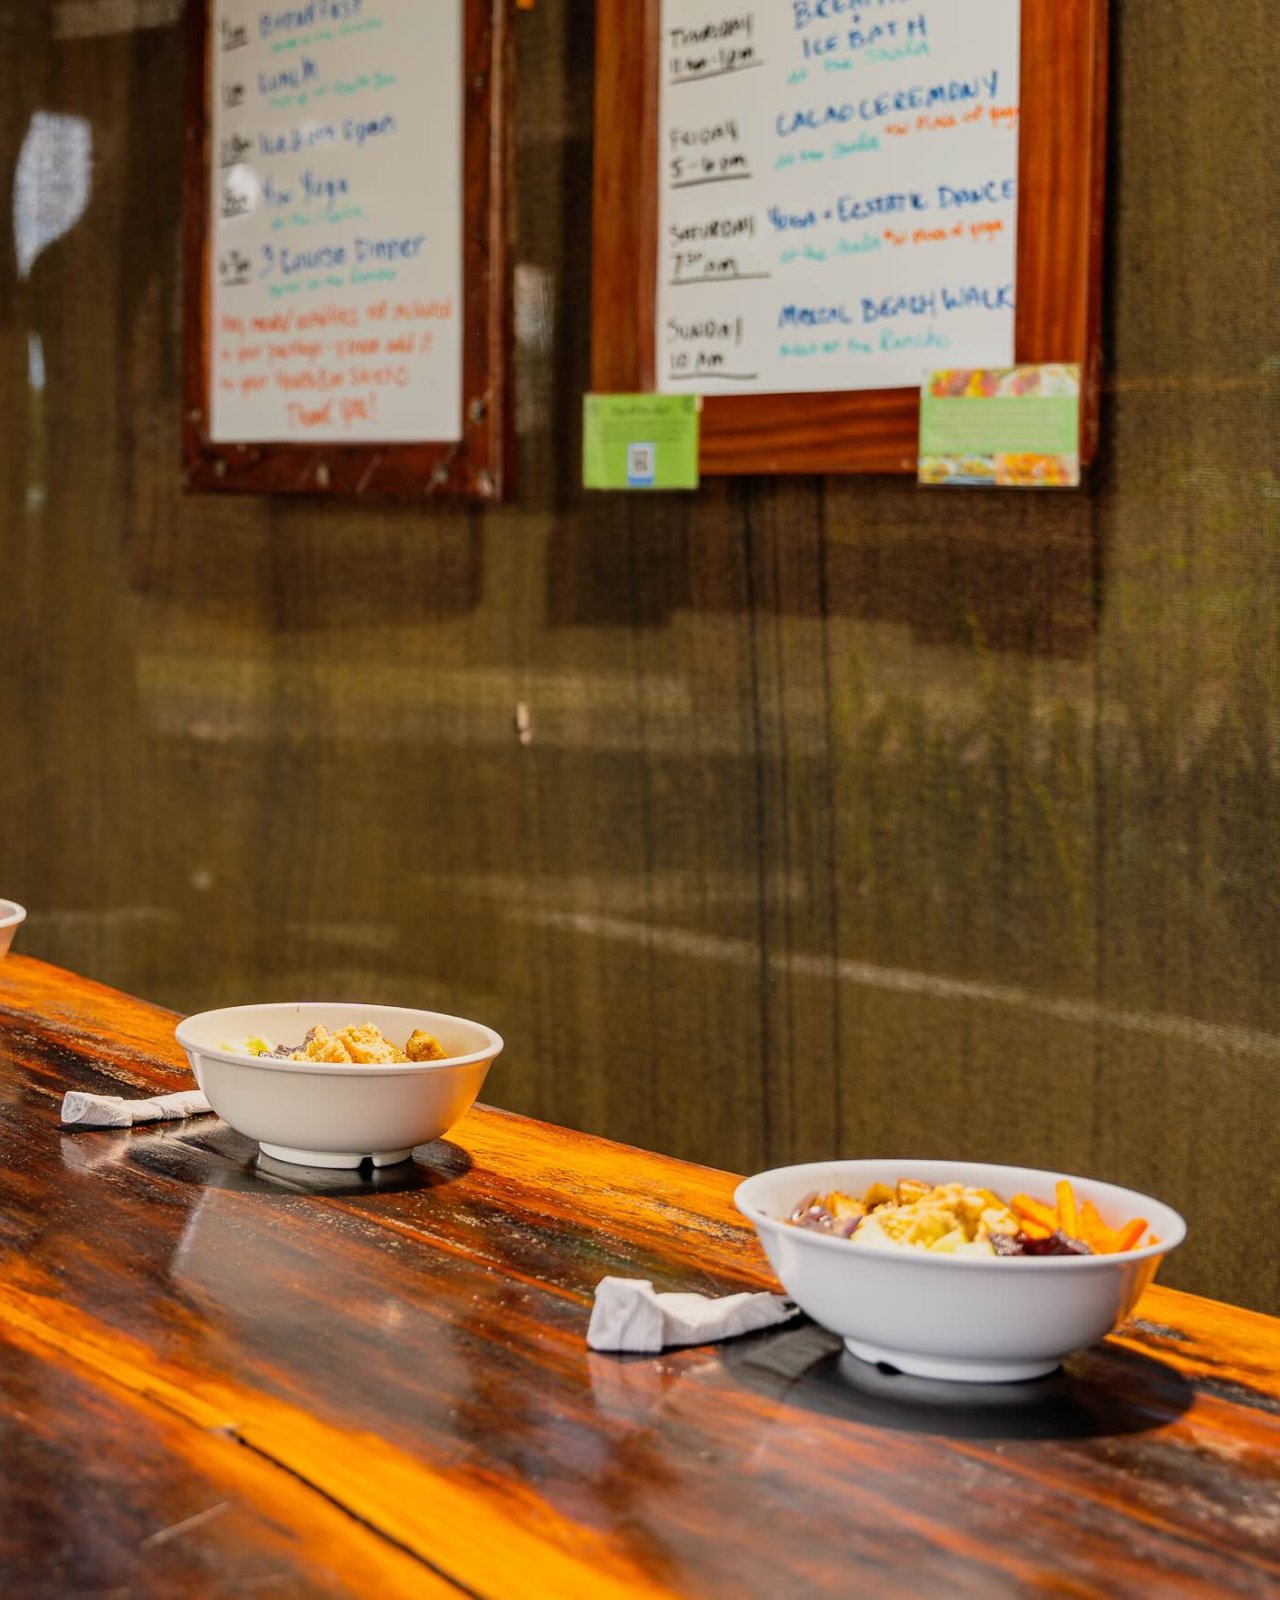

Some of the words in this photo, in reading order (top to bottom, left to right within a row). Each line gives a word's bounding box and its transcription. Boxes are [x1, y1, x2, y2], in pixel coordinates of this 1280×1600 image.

[801, 32, 839, 59] ICE
[847, 12, 929, 49] BATH
[775, 103, 854, 138] CACAO
[859, 69, 1000, 121] CEREMONY
[669, 117, 739, 152] FRIDAY
[936, 177, 1016, 210] DANCE
[670, 215, 756, 244] SATURDAY
[860, 288, 939, 324] BEACH
[940, 281, 1016, 312] WALK
[666, 315, 743, 347] SUNDAY
